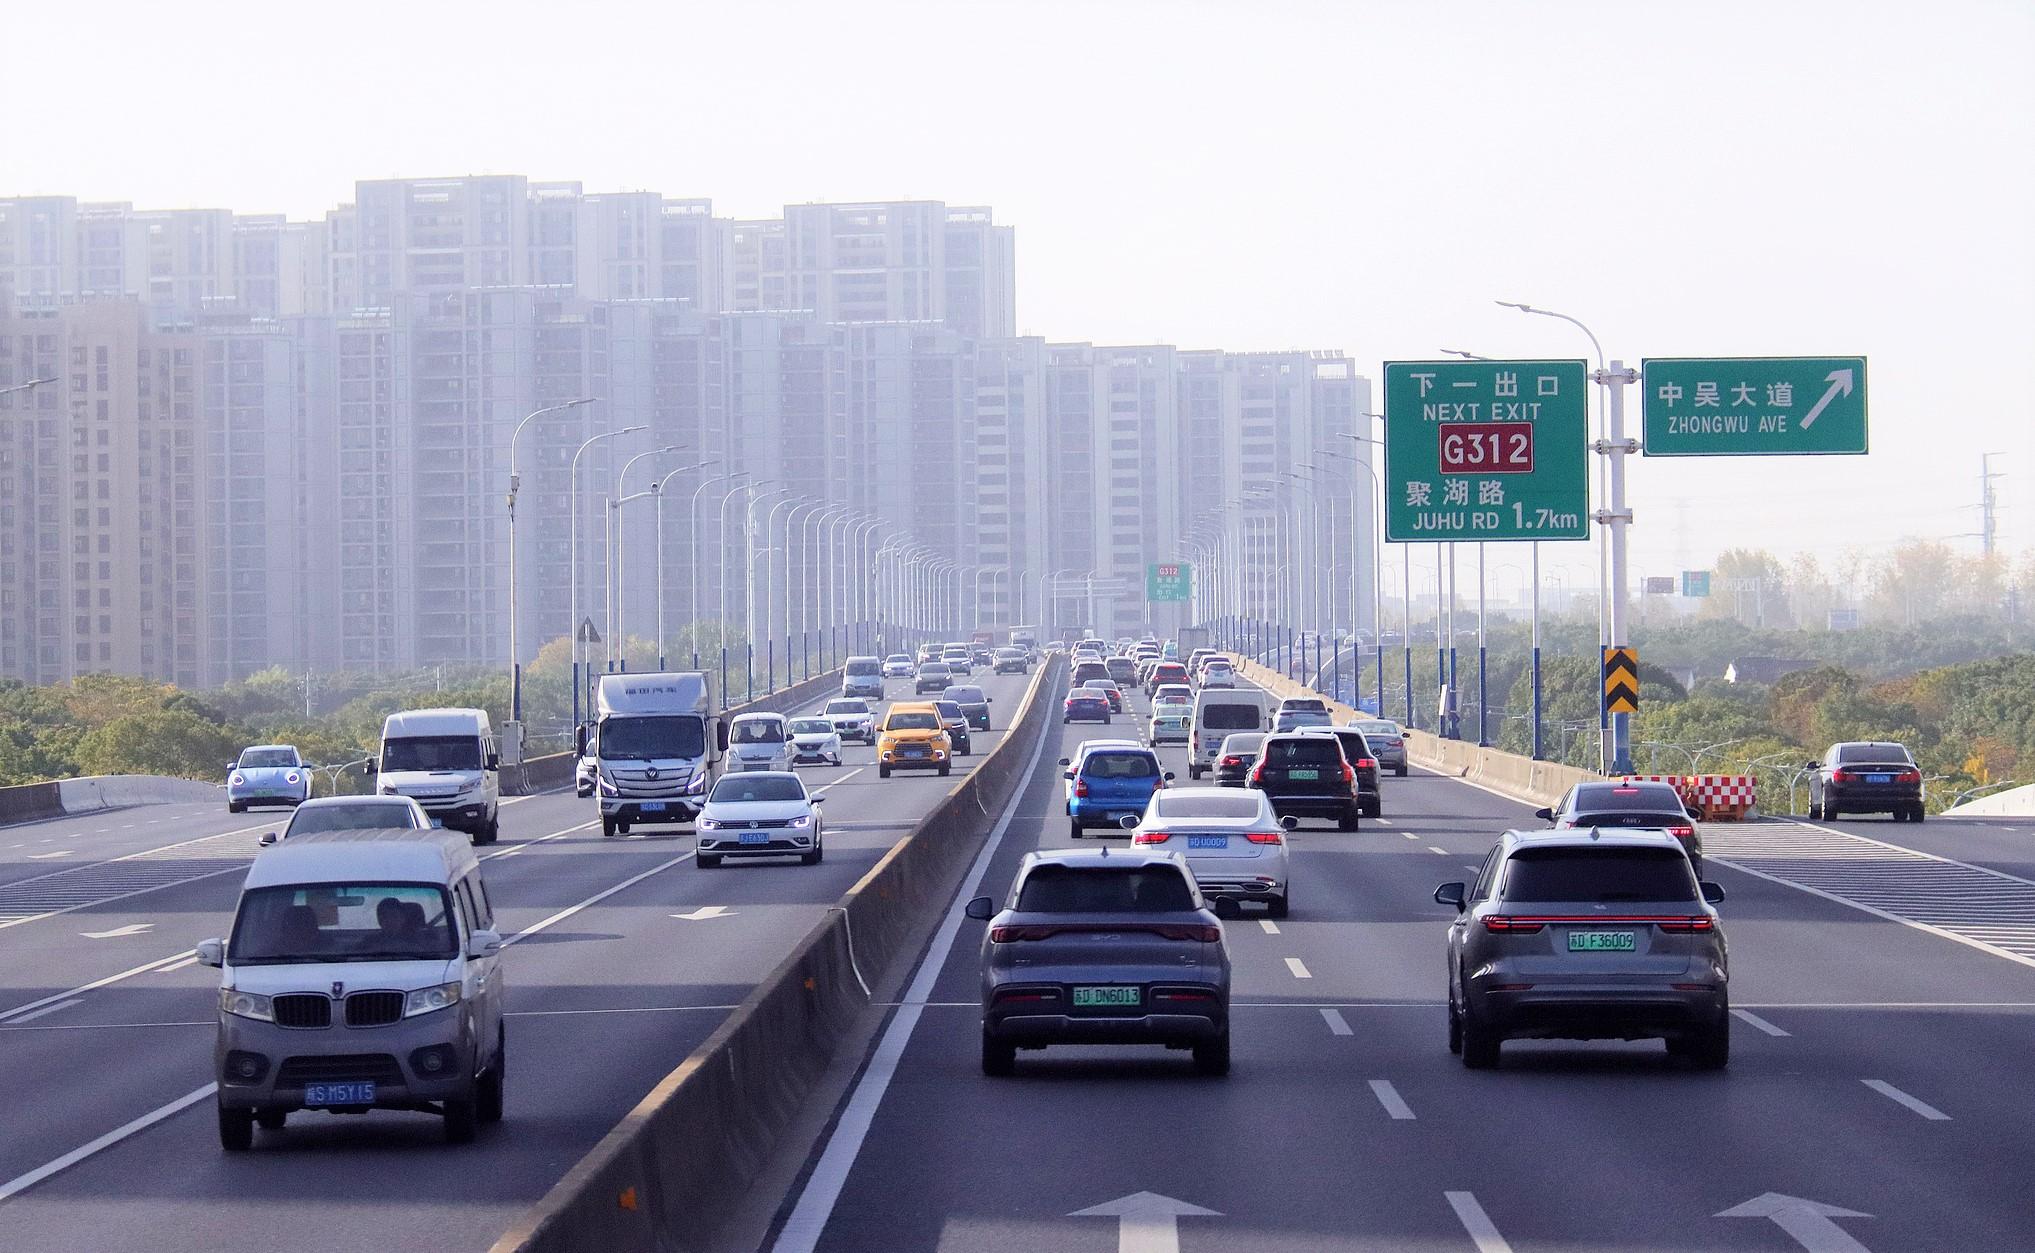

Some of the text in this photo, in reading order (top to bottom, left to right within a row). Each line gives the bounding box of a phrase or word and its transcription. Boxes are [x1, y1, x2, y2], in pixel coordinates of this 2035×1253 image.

[1410, 371, 1559, 398] 下一出口
[1658, 381, 1793, 407] 中吴大道
[1423, 402, 1542, 421] NEXT EXIT
[1668, 415, 1787, 434] ZHONGWU AVE
[1444, 433, 1528, 464] G312
[1406, 478, 1505, 507] 聚湖路
[1412, 511, 1500, 530] JUHU RD
[1512, 501, 1578, 529] 1.7km
